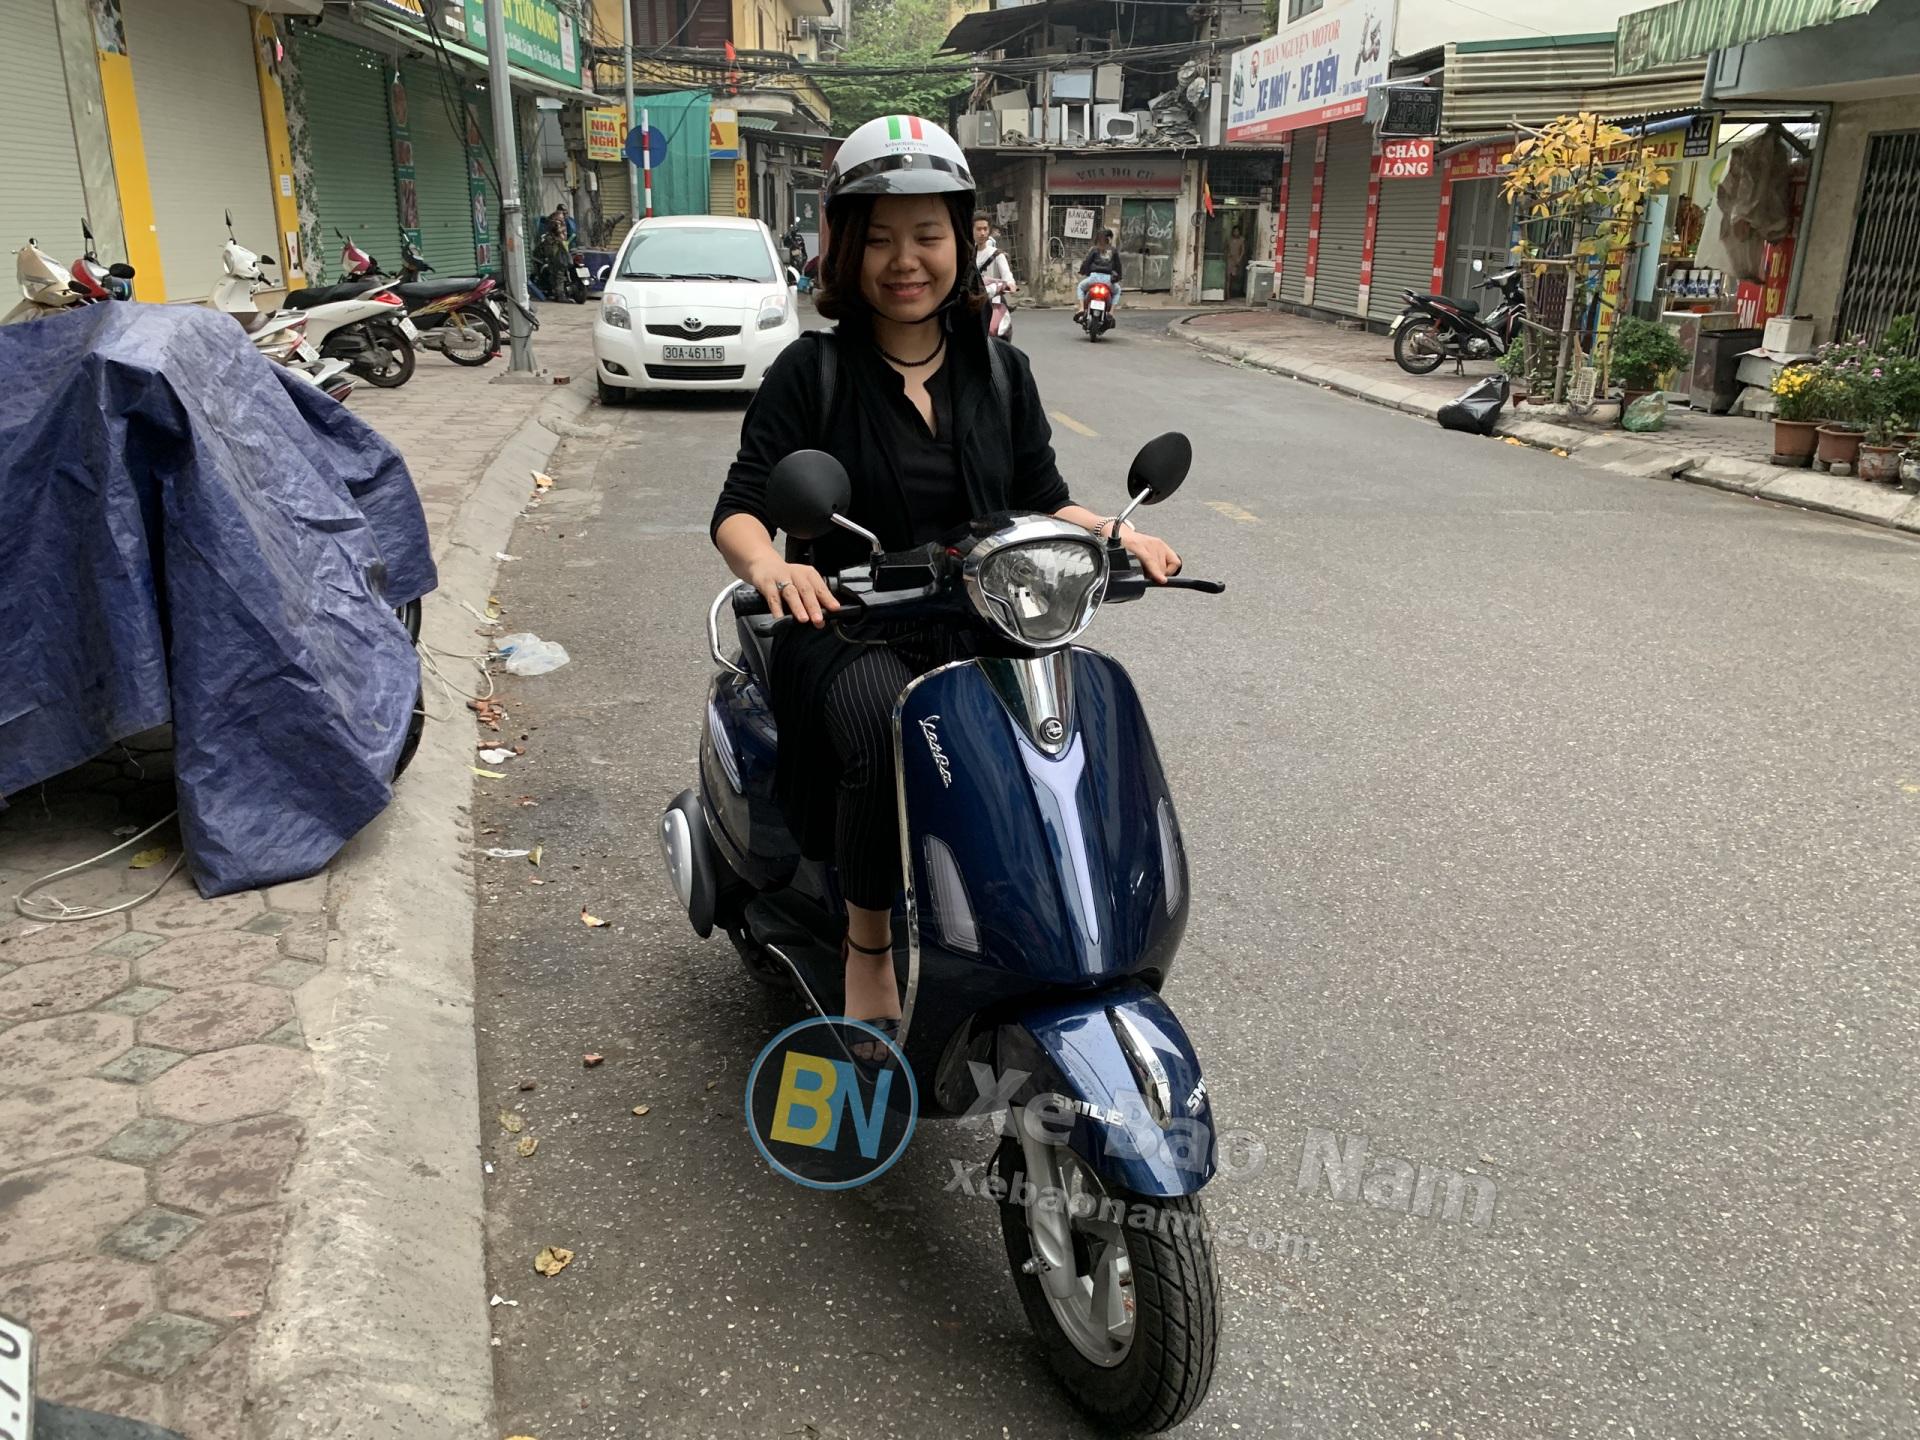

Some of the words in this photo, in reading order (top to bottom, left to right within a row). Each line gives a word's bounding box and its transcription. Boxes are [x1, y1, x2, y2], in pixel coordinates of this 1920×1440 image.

[1312, 19, 1341, 47] MOTOR
[1257, 78, 1269, 112] XE
[1268, 66, 1291, 110] MÁY
[1298, 64, 1313, 102] XE
[1389, 102, 1436, 124] LAPTOP
[1385, 141, 1430, 159] CHÁO
[1384, 158, 1429, 176] LÒNG
[665, 347, 723, 359] 30A-461.15
[1053, 1092, 1124, 1127] SMILE
